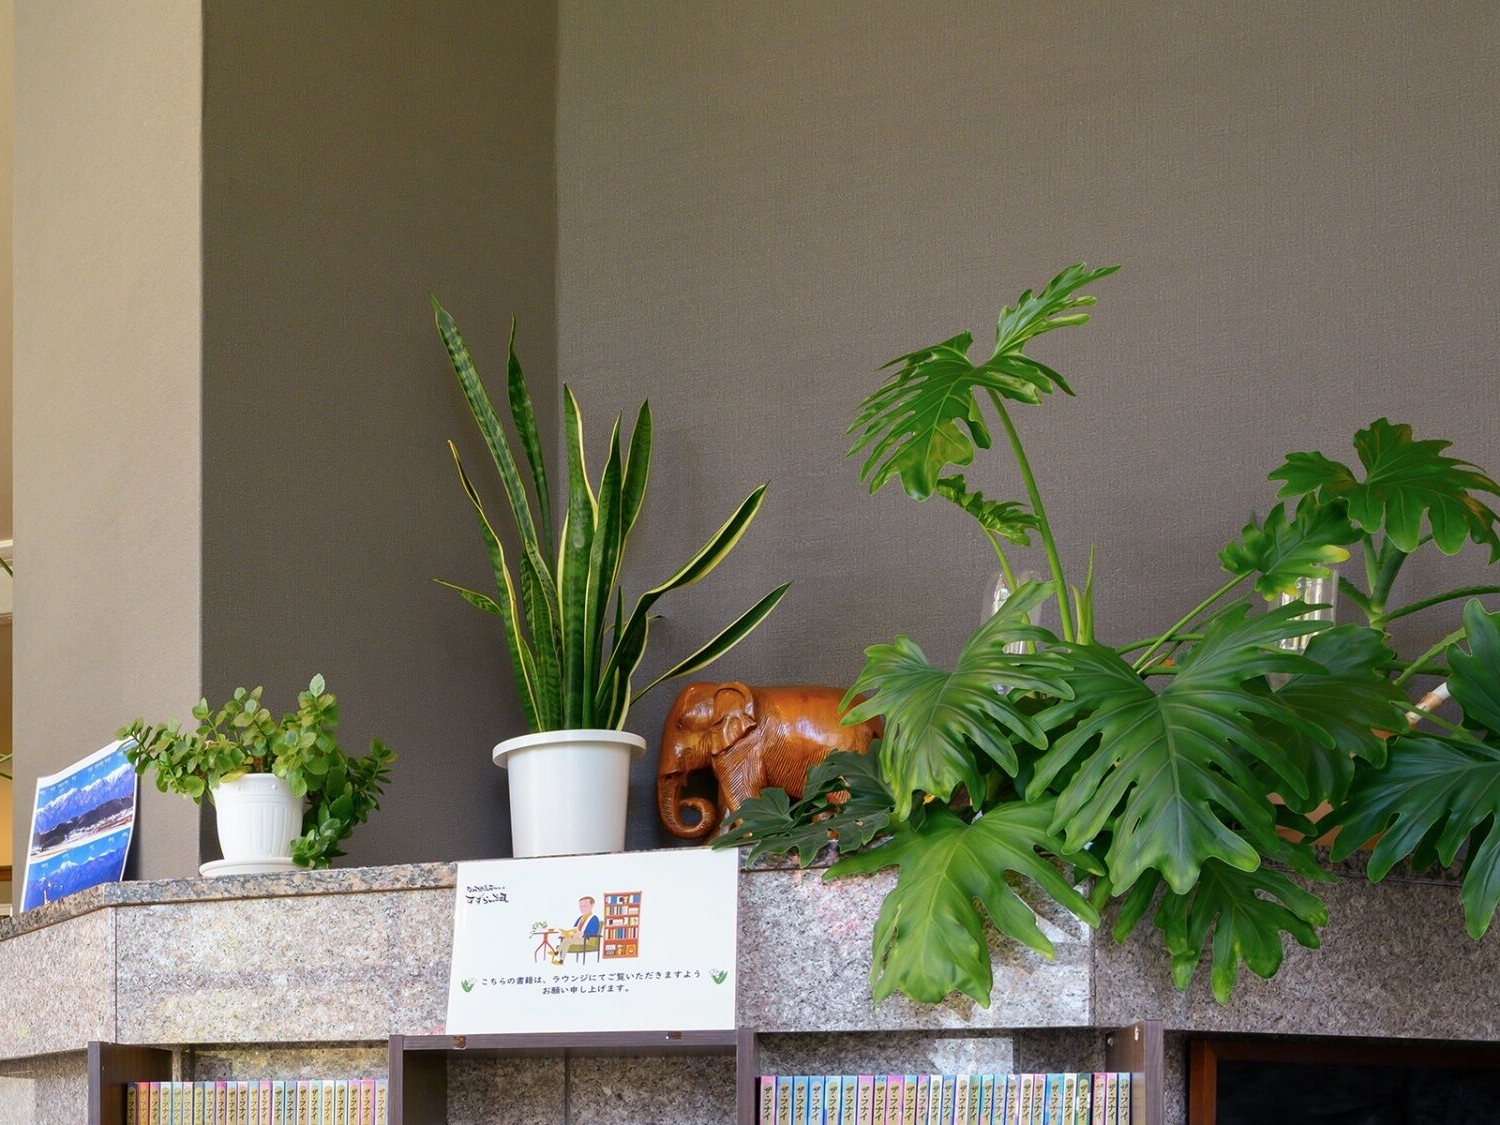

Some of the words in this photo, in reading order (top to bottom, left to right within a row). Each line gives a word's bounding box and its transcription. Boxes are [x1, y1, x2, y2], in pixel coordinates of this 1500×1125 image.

[481, 969, 701, 986] こちらの書籍は、ラウンジにてご覧いただきますよう
[542, 985, 630, 995] お願い申し上げます。
[763, 1086, 772, 1120] ザ・フナイ
[780, 1086, 788, 1120] ザ・フナイ
[796, 1086, 804, 1120] ザ・フナイ
[812, 1086, 820, 1120] ザ・フナイ
[828, 1086, 837, 1120] ザ・フナイ
[845, 1086, 854, 1120] ザ・フナイ
[860, 1086, 869, 1120] ザ・フナイ
[876, 1086, 884, 1120] ザ・フナイ
[905, 1086, 914, 1120] ザ・フナイ
[931, 1086, 940, 1120] ザ・フナイ
[958, 1086, 967, 1120] ザ・フナイ
[1023, 1084, 1031, 1120] ザ・フナイ
[1035, 1084, 1043, 1120] ザ・フナイ
[1051, 1084, 1059, 1120] ザ・フナイ
[1065, 1084, 1074, 1120] ザ・フナイ
[1079, 1084, 1088, 1120] ザ・フナイ
[1109, 1084, 1117, 1120] ザ・フナイ
[1120, 1084, 1128, 1120] ザ・フナイ
